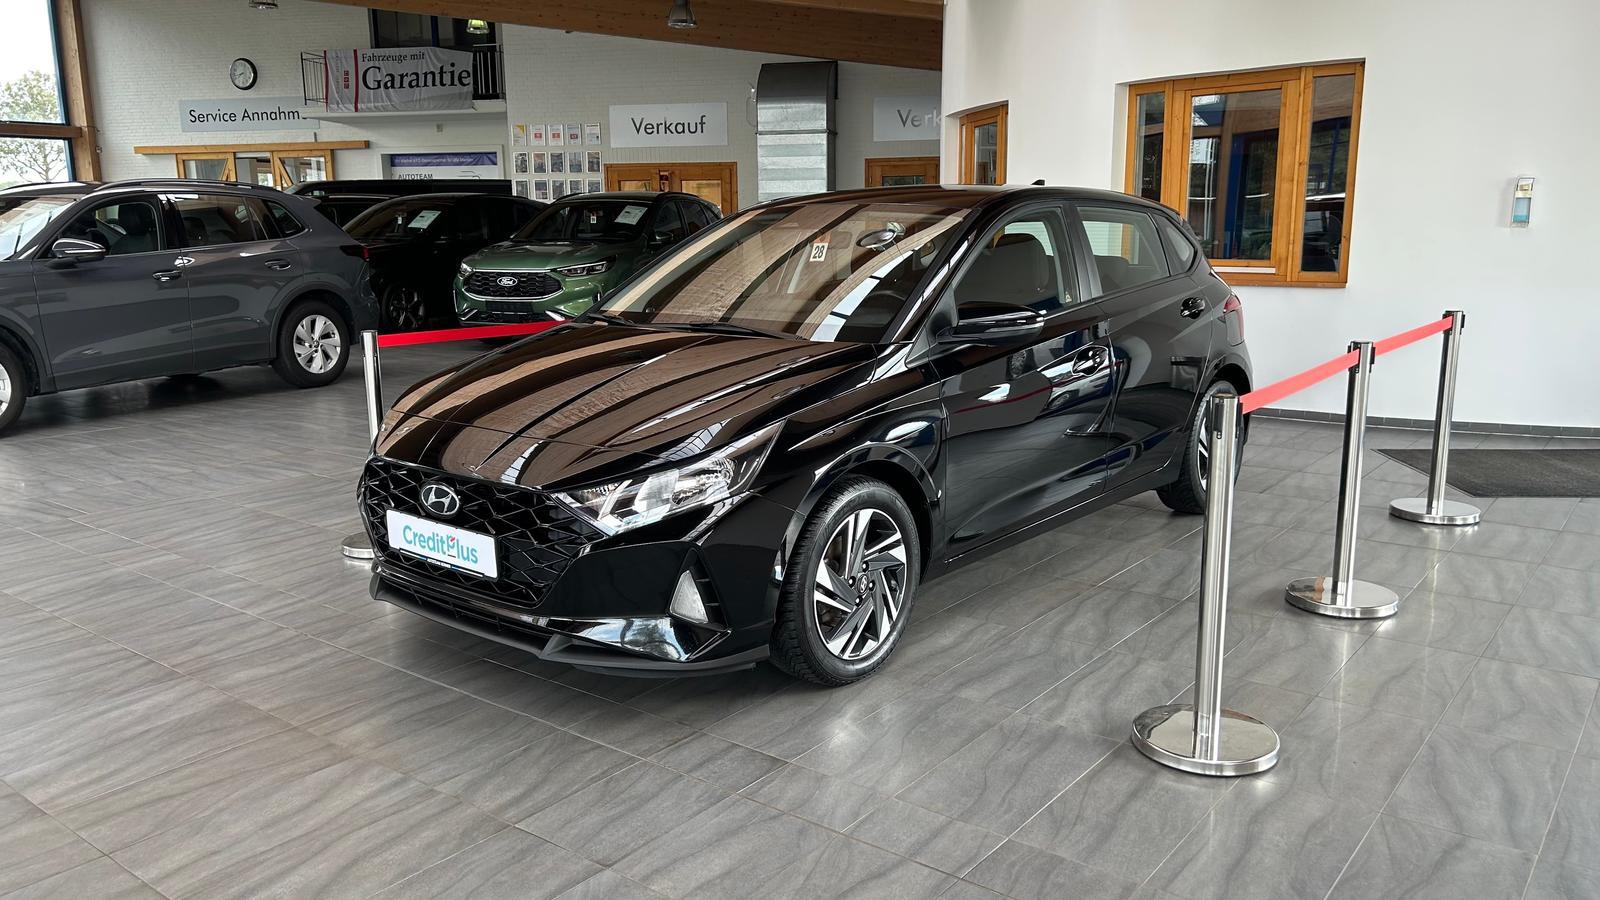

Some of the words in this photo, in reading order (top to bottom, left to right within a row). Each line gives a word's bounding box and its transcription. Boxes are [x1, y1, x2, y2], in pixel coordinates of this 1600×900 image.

[361, 52, 408, 63] Fahrzeuge
[410, 51, 425, 61] mit
[361, 62, 472, 91] Garantie
[189, 108, 237, 123] Service
[241, 106, 307, 122] Annahm
[631, 115, 706, 135] Verkauf
[812, 245, 825, 259] 28
